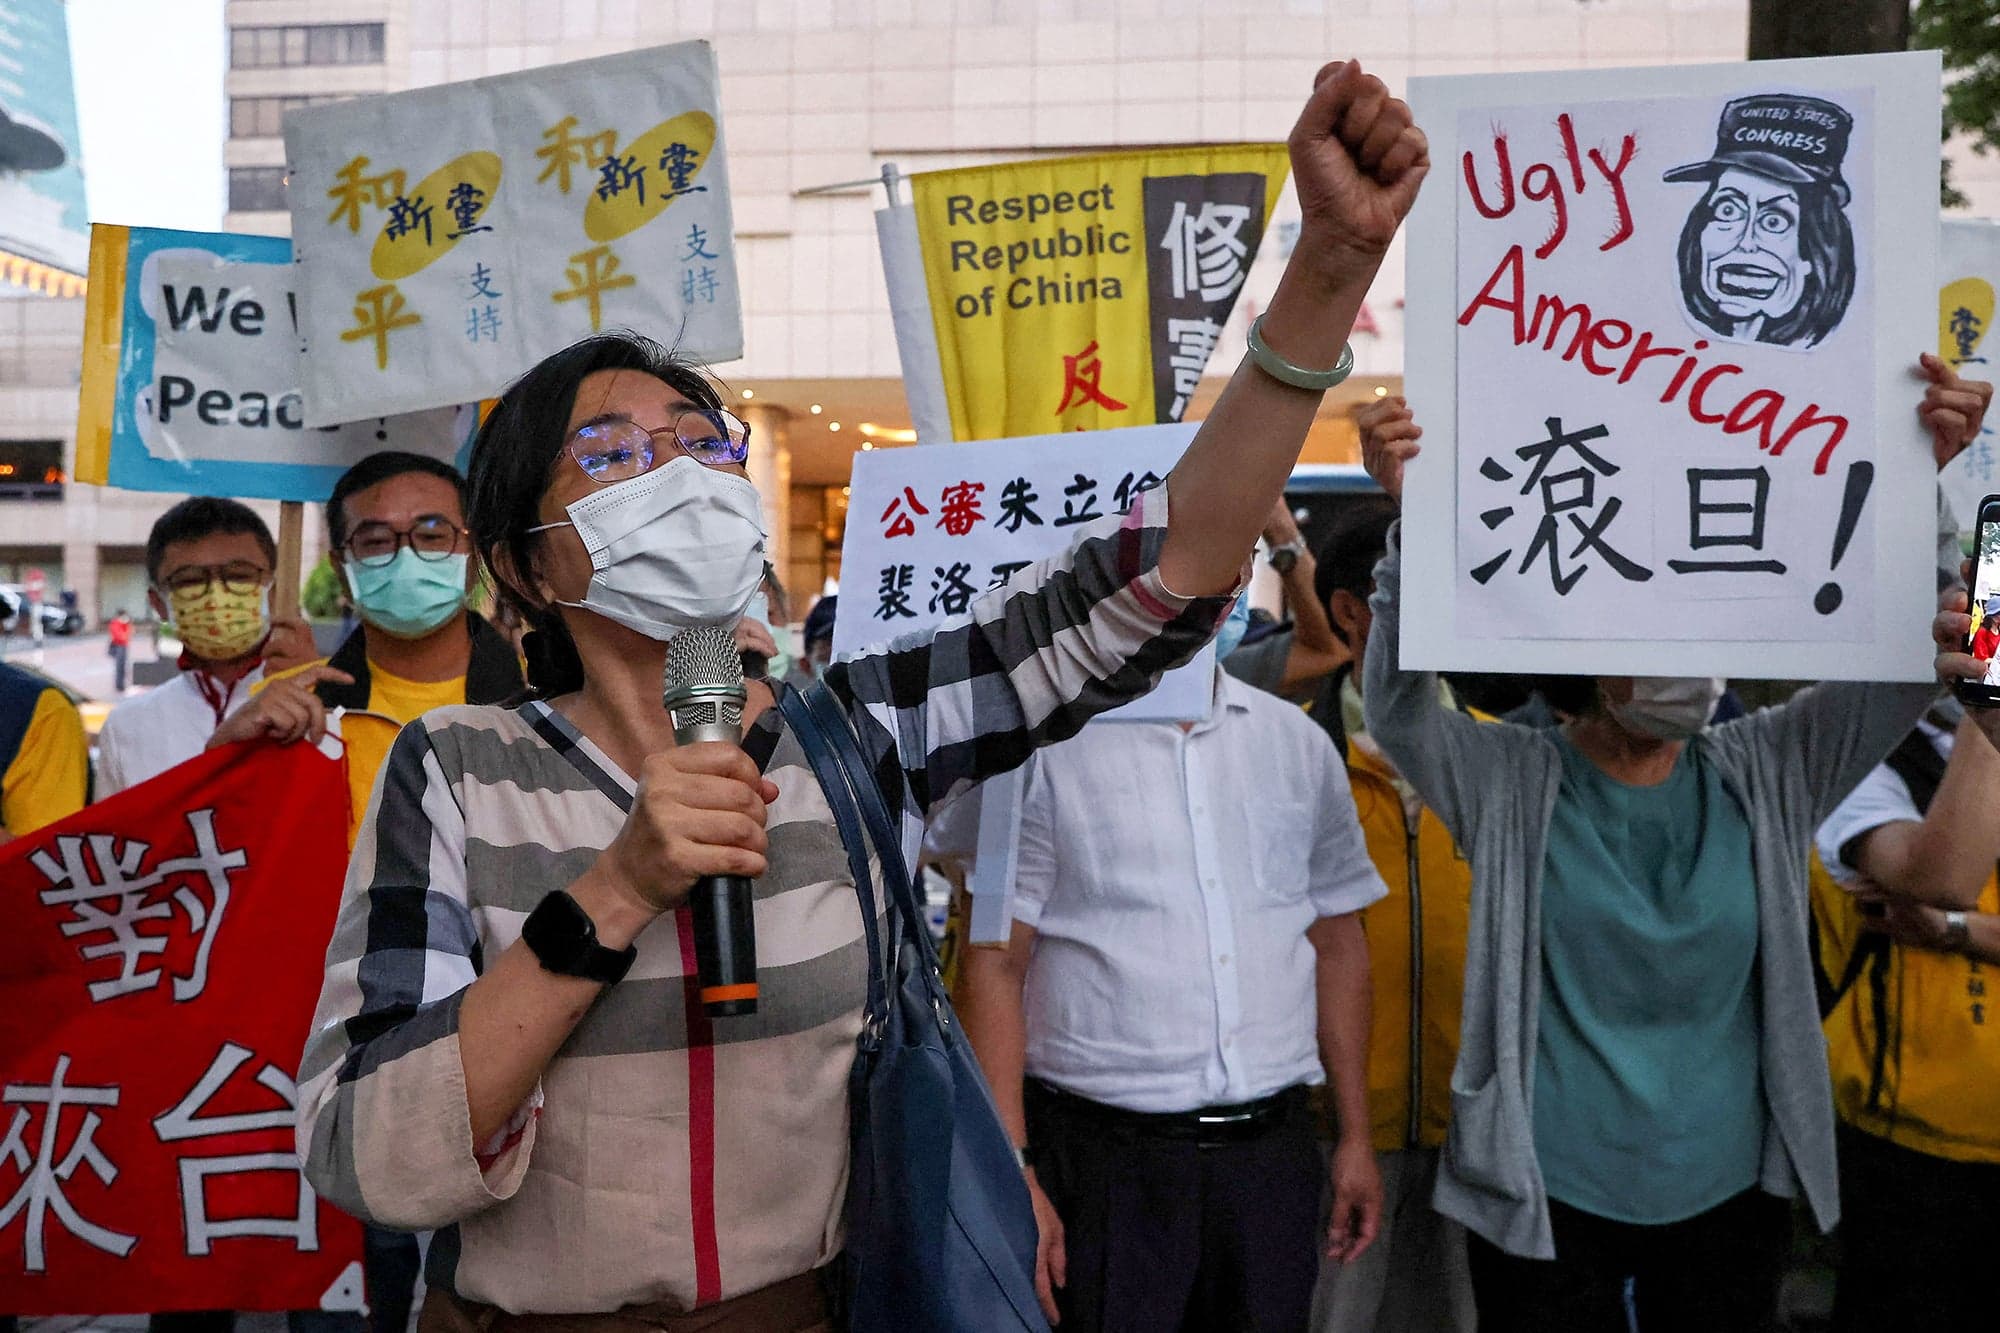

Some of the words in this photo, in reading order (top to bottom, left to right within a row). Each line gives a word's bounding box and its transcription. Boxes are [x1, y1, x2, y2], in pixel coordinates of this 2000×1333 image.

[1734, 126, 1827, 154] CONGRESS
[1741, 107, 1791, 121] UNITED
[1793, 106, 1839, 130] STATES
[946, 182, 1116, 226] Respect
[1462, 112, 1641, 260] Ugly
[950, 225, 1132, 273] Republic
[162, 284, 266, 336] We
[955, 281, 994, 319] of
[1006, 272, 1124, 309] China
[1456, 244, 1851, 475] American
[157, 375, 341, 432] Peac
[25, 807, 249, 1004] 對
